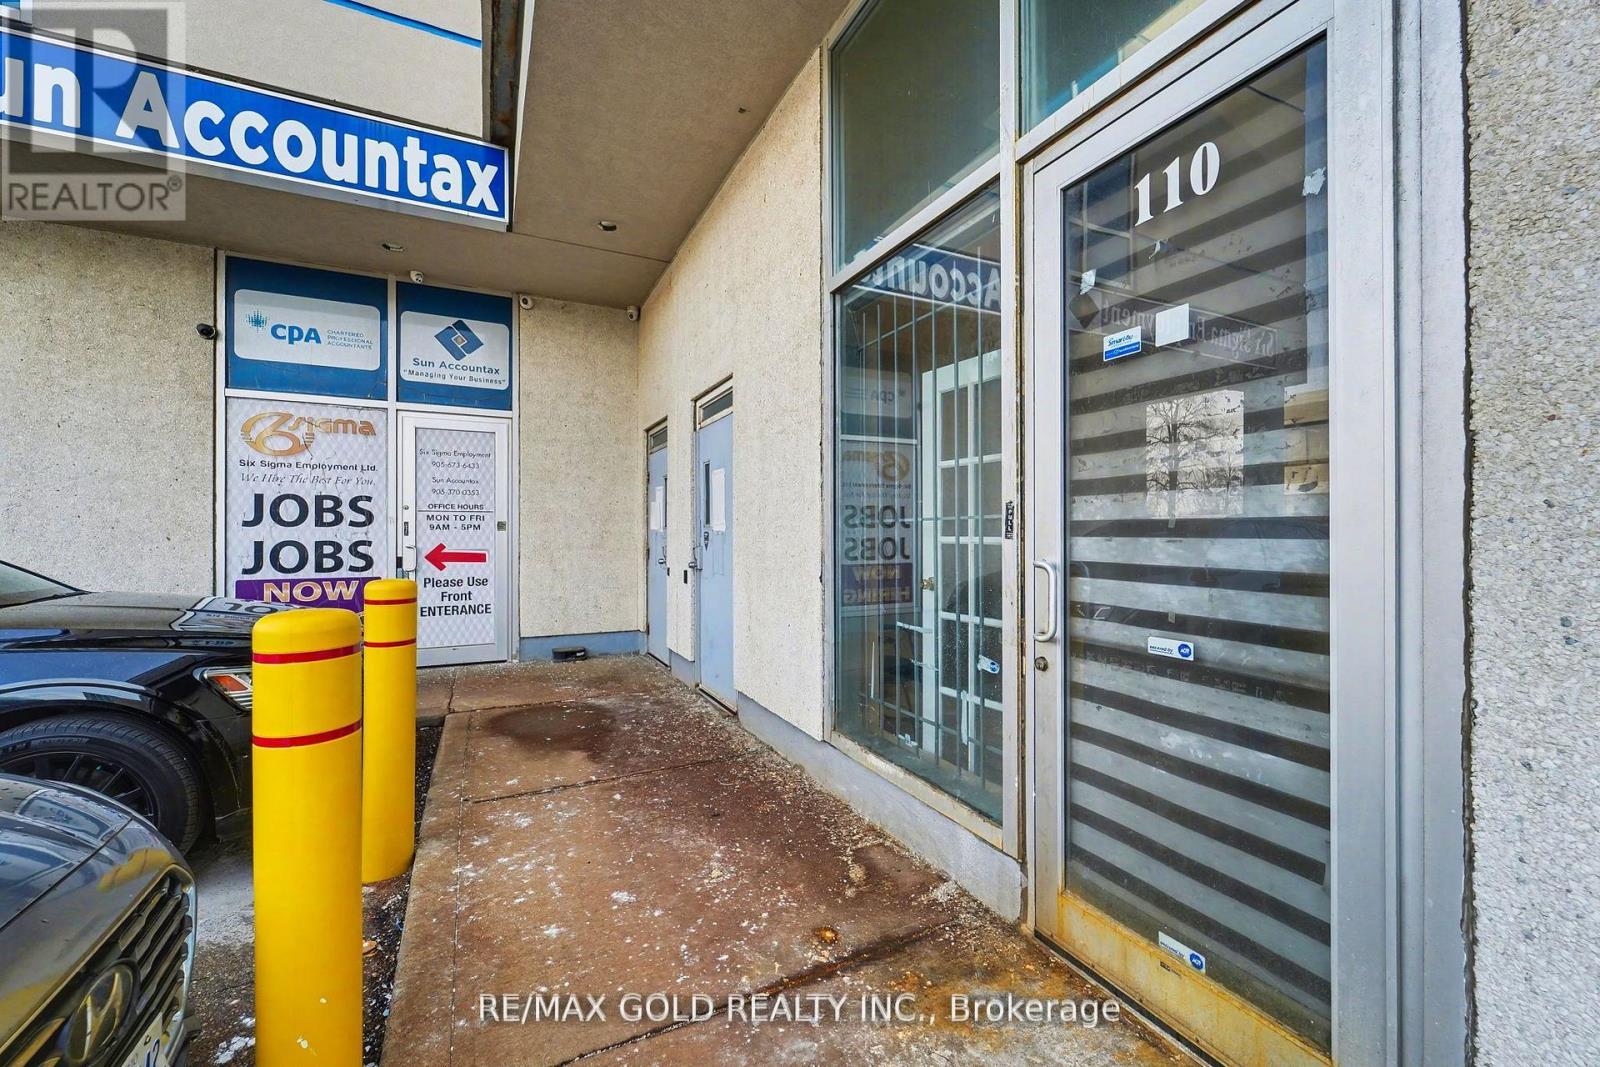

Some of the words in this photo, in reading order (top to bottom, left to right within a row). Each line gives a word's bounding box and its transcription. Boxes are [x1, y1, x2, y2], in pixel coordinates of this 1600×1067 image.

[115, 71, 499, 211] Accountax
[1134, 141, 1220, 227] 110
[327, 329, 364, 338] CHARTERED
[327, 335, 373, 345] PROFESSIONAL
[413, 358, 435, 368] Sun
[439, 361, 500, 375] Accountax
[449, 373, 466, 381] Your
[431, 449, 452, 457] Sigma
[453, 450, 491, 459] Employment
[239, 459, 256, 467] Six
[260, 460, 292, 470] Sigma
[295, 461, 357, 471] Employment
[360, 464, 378, 472] Ltd.
[241, 472, 258, 482] We
[261, 473, 286, 483] Hire
[289, 473, 307, 484] The
[310, 475, 332, 484] Best
[334, 476, 352, 484] For
[432, 476, 444, 484] Sun
[241, 493, 375, 528] JOBS
[429, 523, 450, 531] 9AM
[461, 523, 481, 531] 5PM
[241, 540, 375, 575] JOBS
[423, 577, 464, 588] Please
[467, 576, 489, 587] Use
[263, 580, 360, 603] NOW
[441, 590, 473, 601] Front
[420, 603, 492, 617] ENTERANCE
